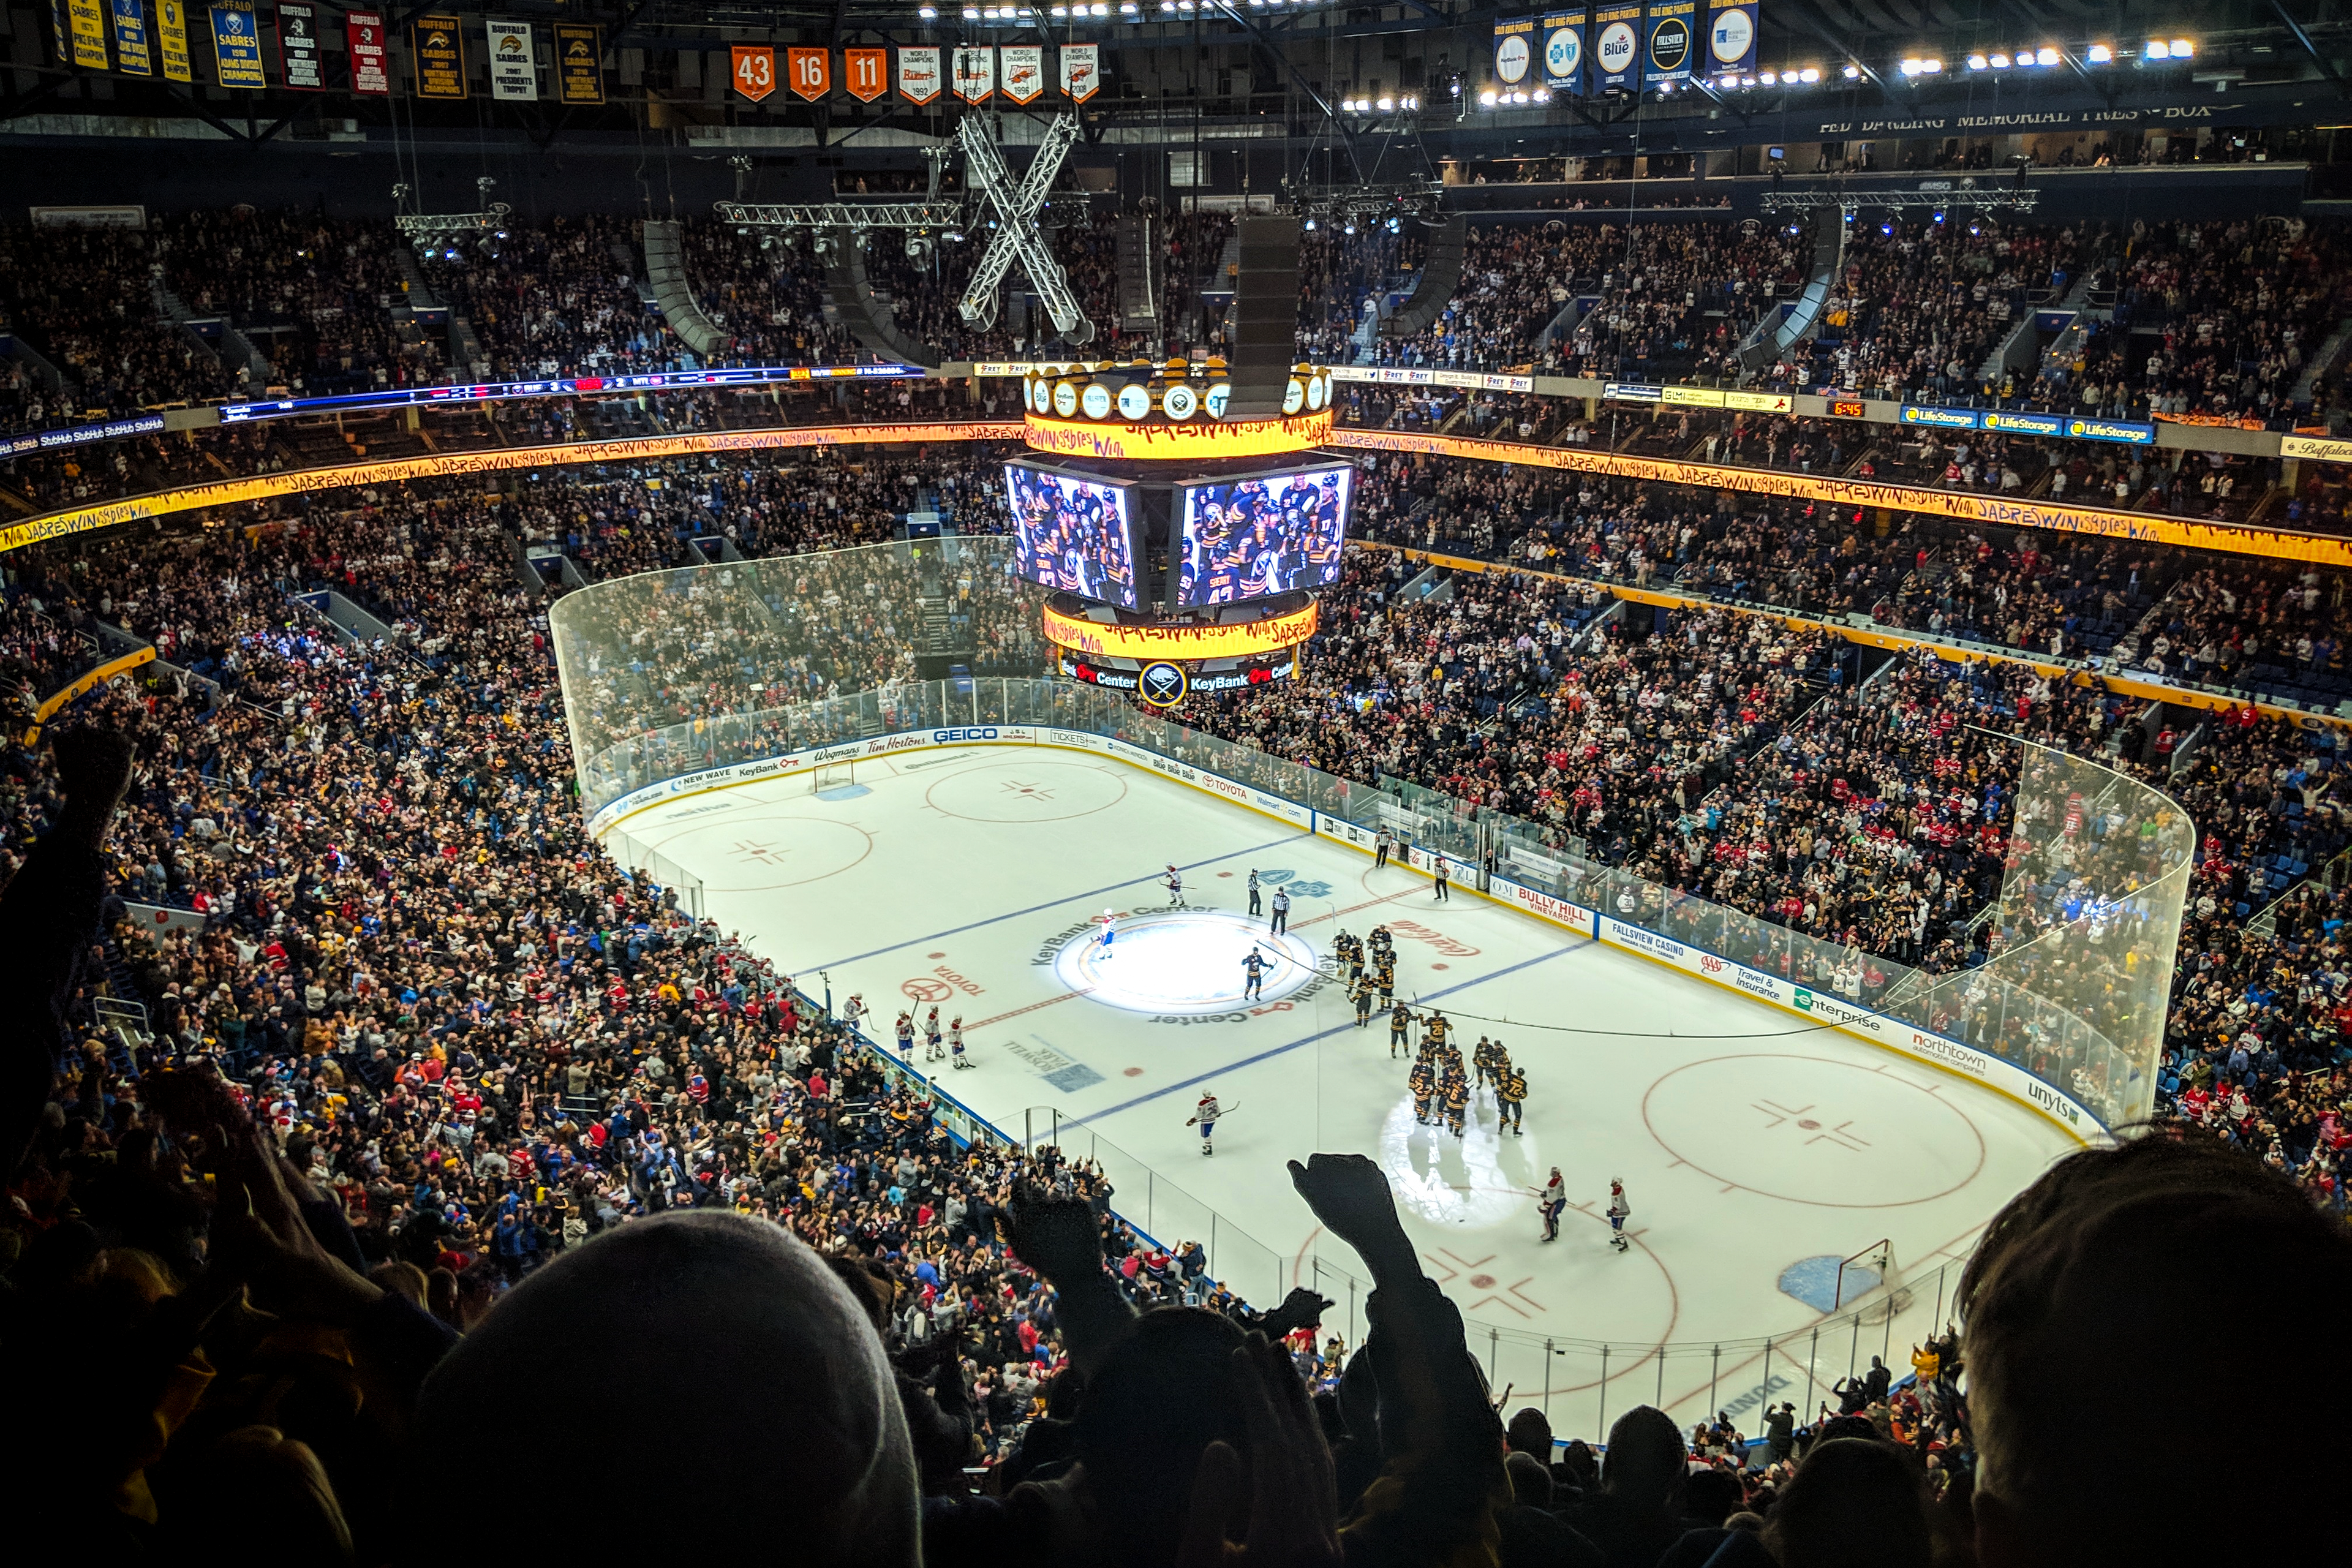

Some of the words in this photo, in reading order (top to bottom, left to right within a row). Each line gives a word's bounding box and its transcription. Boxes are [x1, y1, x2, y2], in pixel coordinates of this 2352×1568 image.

[72, 4, 99, 21] SABRES
[279, 5, 312, 17] BUFFALO
[1596, 12, 1608, 23] GOLD
[1619, 7, 1640, 19] PARTNER
[1673, 2, 1695, 15] PARTNER
[350, 15, 380, 26] BUFFALO
[418, 20, 454, 30] BUFFALO
[491, 24, 527, 35] BUFFALO
[560, 29, 594, 39] BUFFALO
[219, 34, 255, 47] SABRES
[284, 36, 315, 48] SABRES
[355, 45, 382, 56] SABRES
[421, 48, 456, 59] SABRES
[1604, 43, 1629, 56] Blue
[496, 53, 528, 63] SABRES
[564, 57, 595, 67] SABRES
[737, 56, 771, 86] 43
[796, 56, 823, 86] 16
[856, 58, 877, 86] 11
[912, 87, 929, 96] 1992
[1014, 86, 1030, 96] 1996
[616, 378, 624, 388] 2
[633, 377, 650, 386] MTL
[1409, 371, 1428, 380] FREY
[1487, 376, 1504, 385] FREY
[1510, 378, 1528, 386] FREY
[524, 383, 542, 394] BUF
[550, 382, 560, 392] 3
[1834, 402, 1861, 417] 6:45
[13, 439, 39, 451] StubHub
[40, 433, 73, 447] StubHub
[74, 429, 104, 442] StubHub
[105, 424, 134, 437] StubHub
[135, 418, 164, 432] StubHub
[1321, 518, 1332, 532] 17
[1179, 575, 1193, 590] 53
[1096, 673, 1137, 688] Center
[1190, 674, 1248, 691] KeyBank
[1271, 662, 1294, 679] Center
[933, 728, 998, 743] GEICO
[1052, 731, 1086, 744] TICKETS
[867, 739, 885, 755] Tim
[886, 733, 927, 752] Hortons
[813, 745, 861, 763] Wegmans
[739, 762, 778, 778] KeyBank
[1153, 758, 1166, 771] Blue
[1167, 764, 1180, 776] Blue
[683, 774, 703, 785] NEW
[705, 769, 731, 780] WAVE
[1182, 769, 1196, 782] Blue
[683, 781, 703, 791] Energy
[1215, 778, 1247, 800] TOYOTA
[1256, 794, 1280, 812] Walmart
[1133, 905, 1219, 914] Center
[1518, 887, 1556, 910] BULLY
[1559, 902, 1586, 922] HILL
[1529, 902, 1575, 925] VINEYARDS
[1031, 921, 1092, 967] KeyBank
[1612, 922, 1653, 945] FALLSVIEW
[1656, 938, 1684, 957] CASINO
[1620, 937, 1639, 947] NIAGARA
[1639, 943, 1653, 952] FALLS
[1657, 950, 1675, 960] CANADA
[1703, 956, 1721, 971] AAA
[933, 965, 986, 997] TOYOTA
[1738, 967, 1765, 986] Travel
[1766, 978, 1774, 989] &
[1735, 976, 1781, 1000] Insurance
[1148, 1012, 1249, 1026] Center
[1798, 992, 1882, 1032] enterprise
[1432, 1025, 1443, 1036] 28
[1003, 1040, 1060, 1072] ROSWELL
[1912, 1033, 1986, 1070] northtown
[1912, 1045, 1950, 1066] automotive
[1950, 1058, 1985, 1077] companies
[1450, 1089, 1458, 1101] 6
[1509, 1080, 1523, 1095] 72
[2028, 1082, 2069, 1117] unyts
